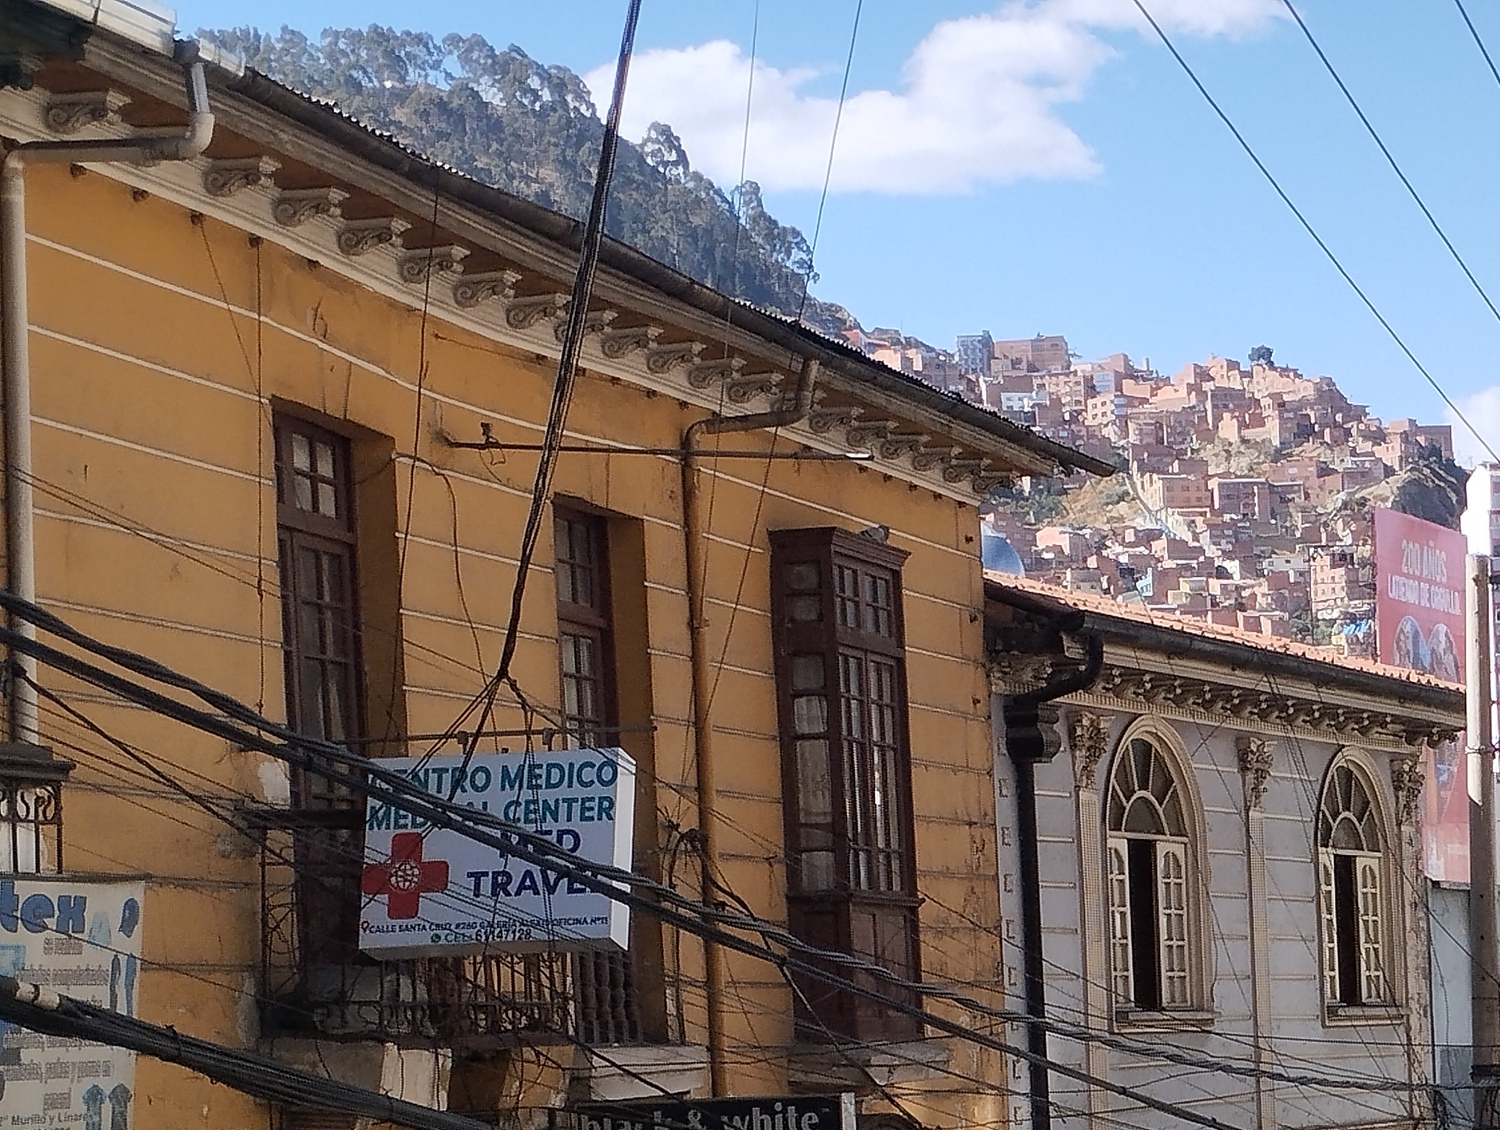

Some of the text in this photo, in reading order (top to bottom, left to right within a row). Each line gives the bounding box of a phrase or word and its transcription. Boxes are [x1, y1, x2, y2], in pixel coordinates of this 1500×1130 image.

[374, 760, 618, 796] NTRO MEDICO
[503, 796, 615, 825] CENTER
[467, 869, 602, 897] TRAVE
[369, 924, 396, 934] CALLE
[399, 922, 427, 932] SANTA
